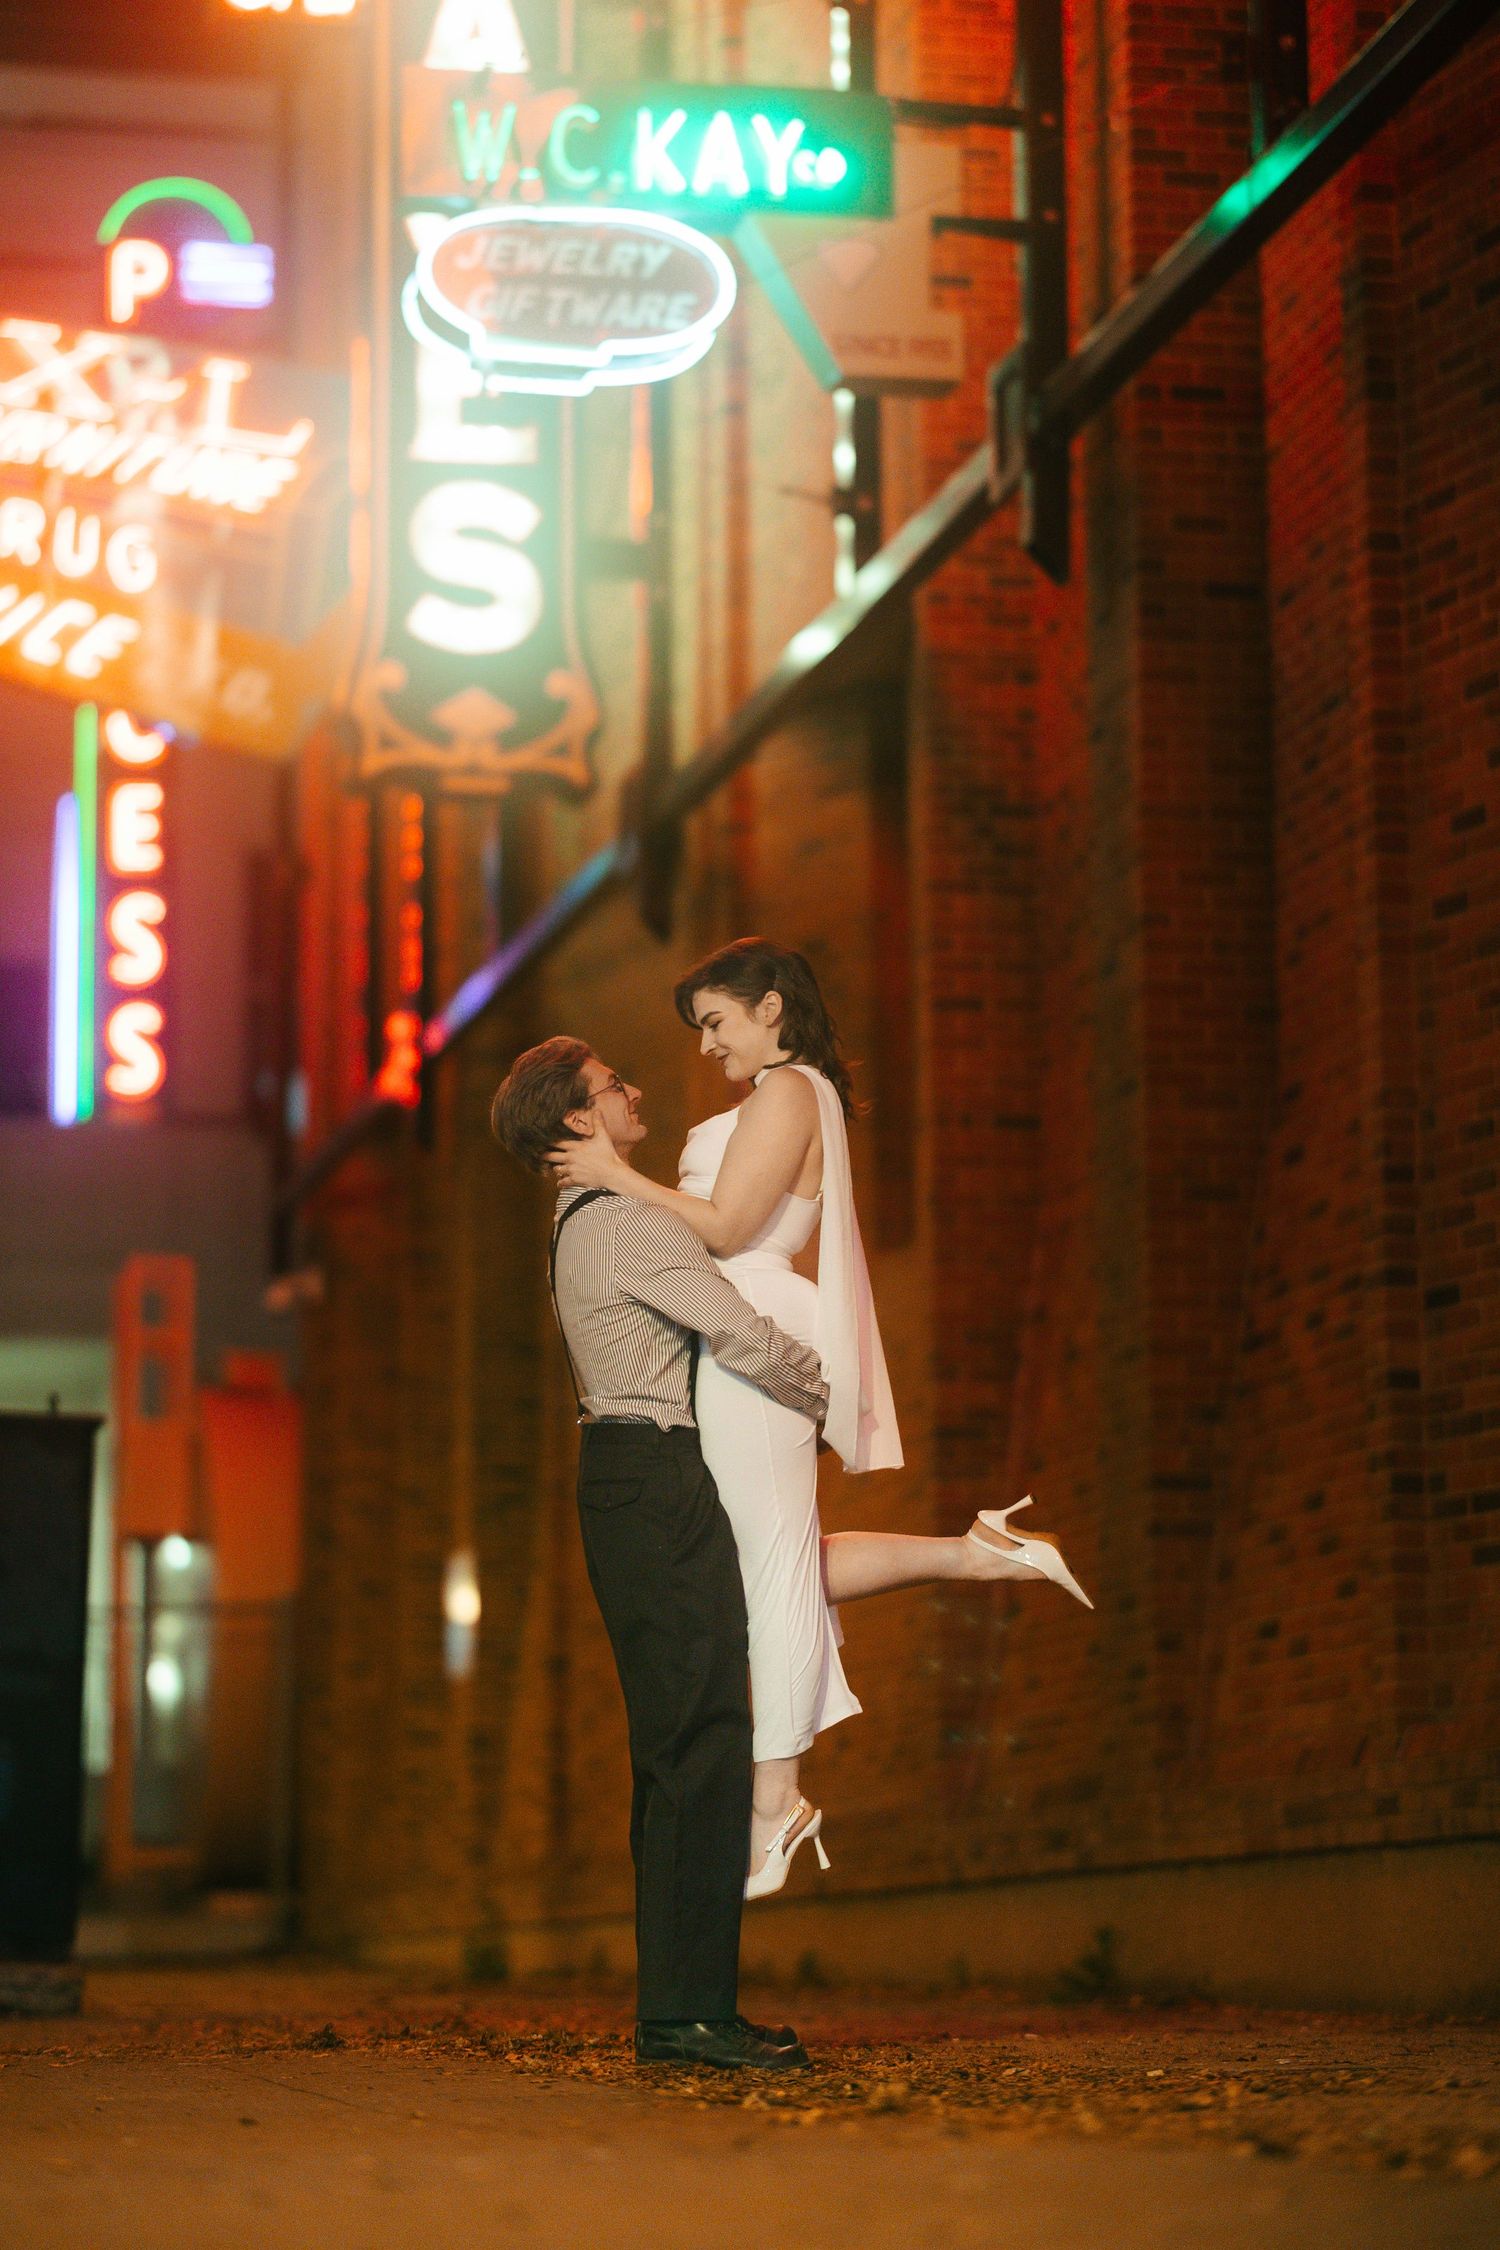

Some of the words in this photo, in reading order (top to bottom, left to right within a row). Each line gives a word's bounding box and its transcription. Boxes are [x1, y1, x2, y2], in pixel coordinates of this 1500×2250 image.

[632, 106, 806, 197] KAY
[453, 235, 673, 279] JEWELRY
[464, 284, 700, 331] GIFTWARE
